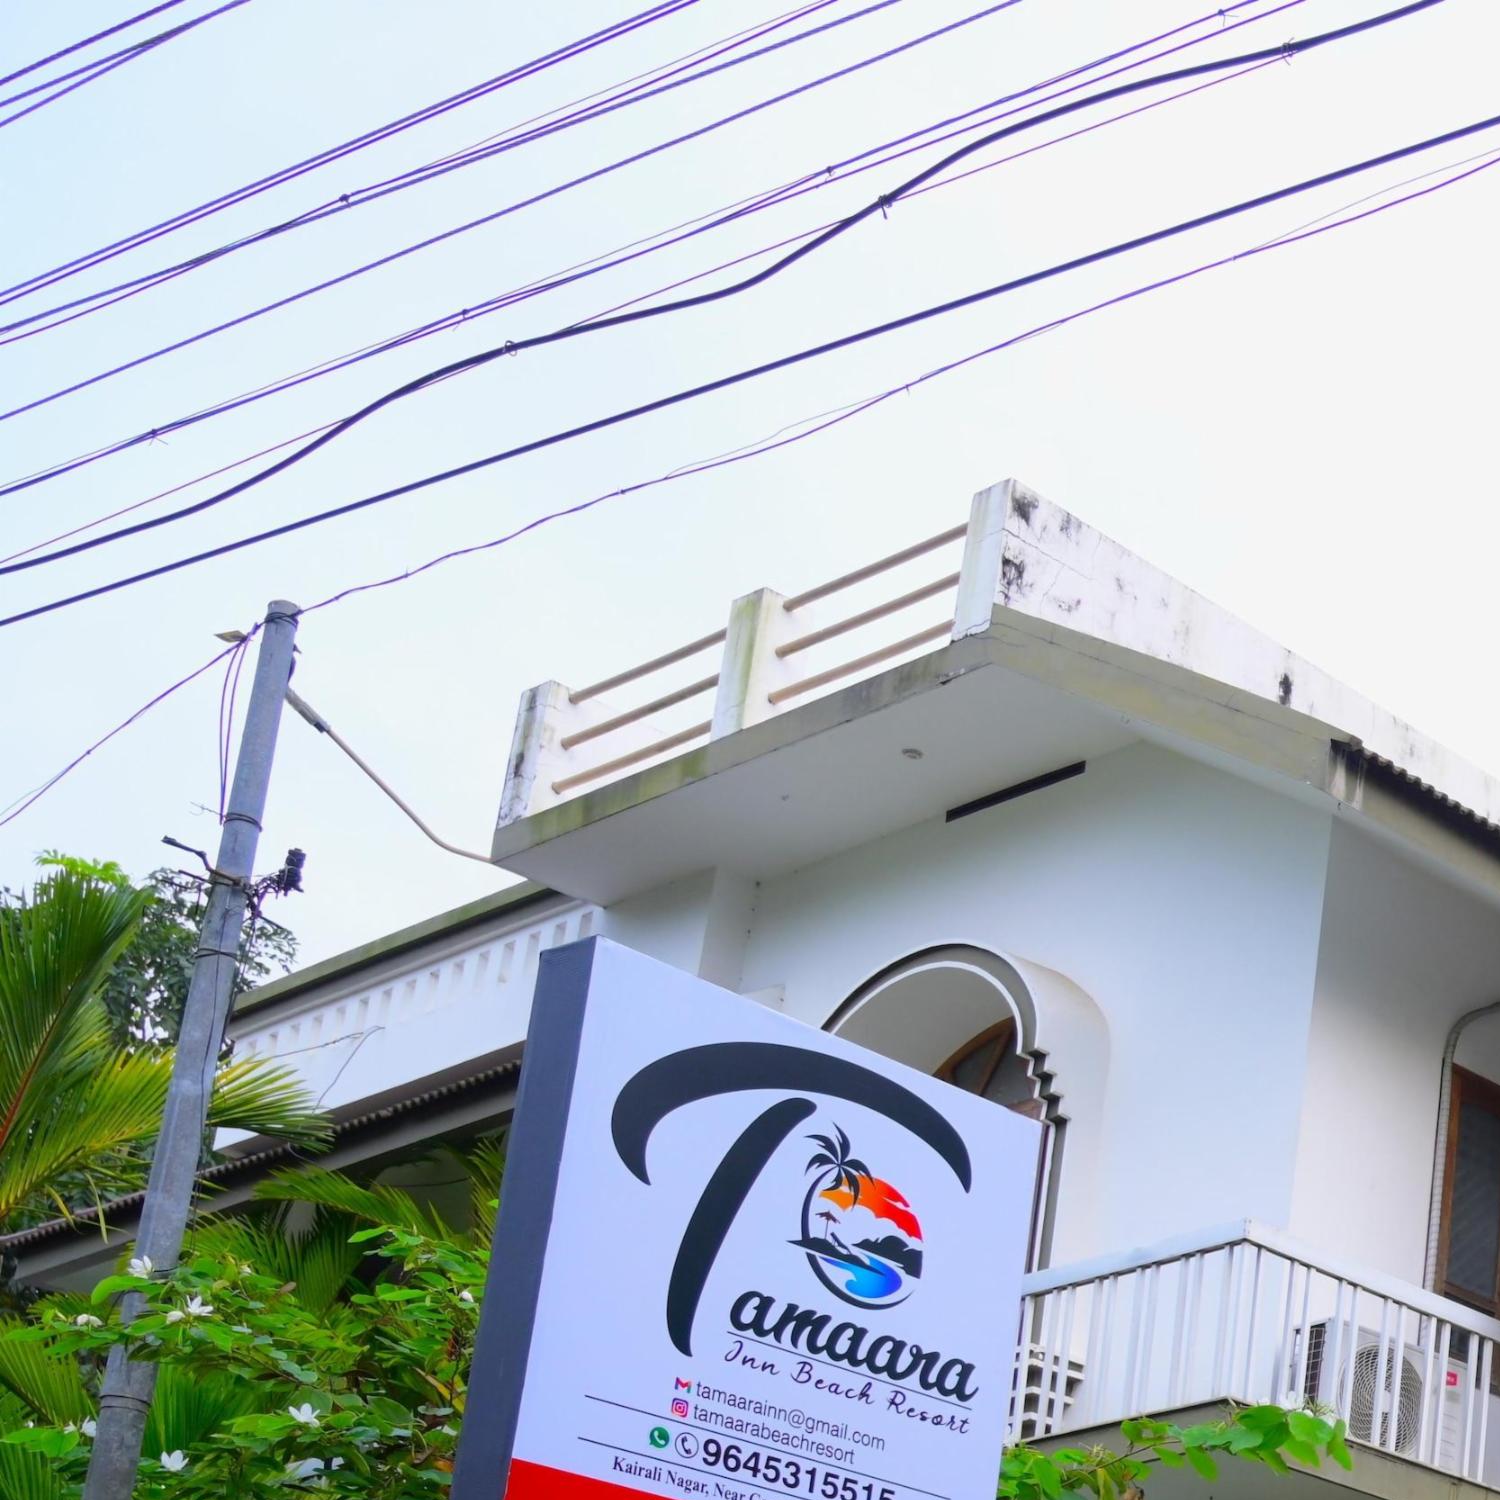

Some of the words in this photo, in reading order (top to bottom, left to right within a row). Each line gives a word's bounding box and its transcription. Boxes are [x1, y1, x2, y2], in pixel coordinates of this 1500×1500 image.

[611, 1041, 979, 1402] Tamaara
[696, 1380, 885, 1450] tamaarainn@gmail.com
[724, 1340, 780, 1375] Inn
[790, 1361, 874, 1405] Beach
[887, 1390, 971, 1434] Resort
[693, 1403, 855, 1465] tamaarabeachresort
[612, 1455, 662, 1482] Kairali
[666, 1470, 710, 1496] Nagar,
